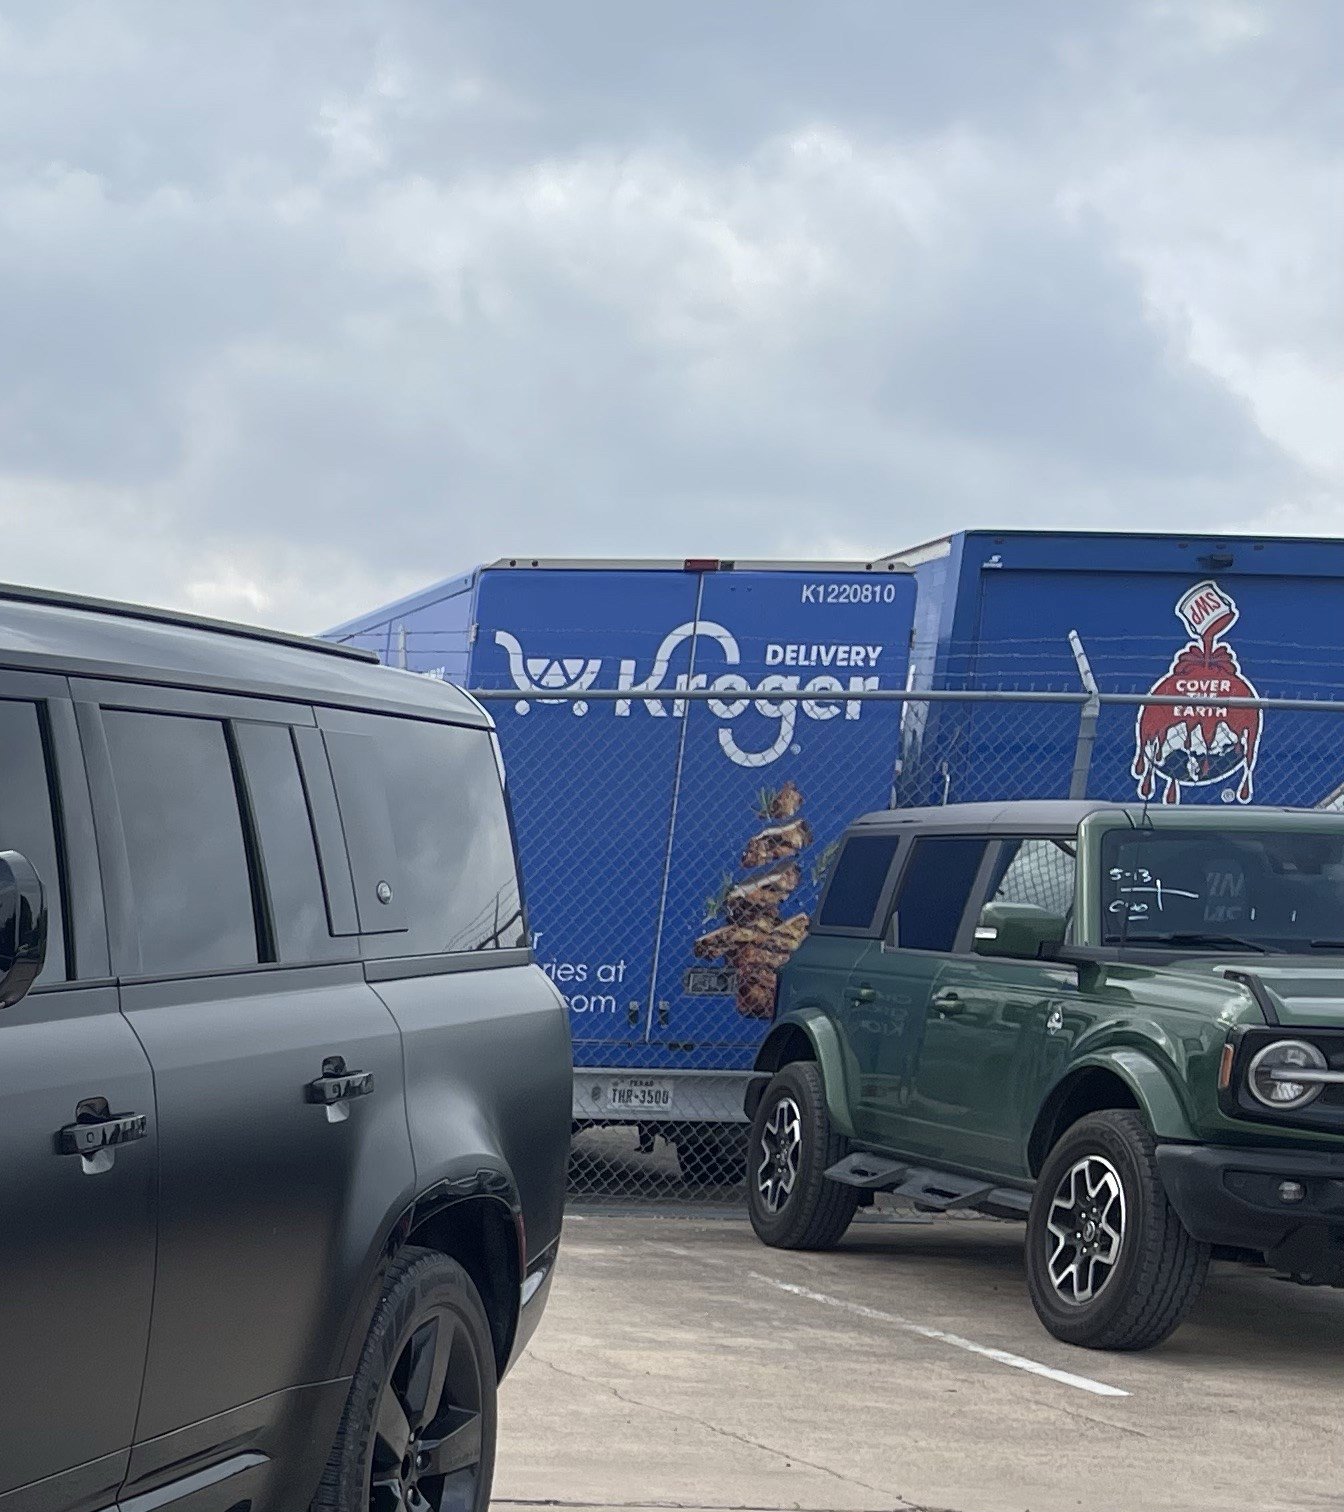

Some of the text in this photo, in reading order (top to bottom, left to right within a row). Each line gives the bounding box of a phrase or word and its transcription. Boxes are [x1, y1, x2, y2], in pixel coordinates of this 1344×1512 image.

[801, 584, 896, 604] K1220810
[1189, 590, 1222, 626] SWP
[765, 644, 883, 668] DELIVERY
[615, 620, 881, 768] Kroger
[1175, 679, 1231, 692] COVER
[1173, 705, 1227, 718] EARTH
[597, 959, 628, 983] at
